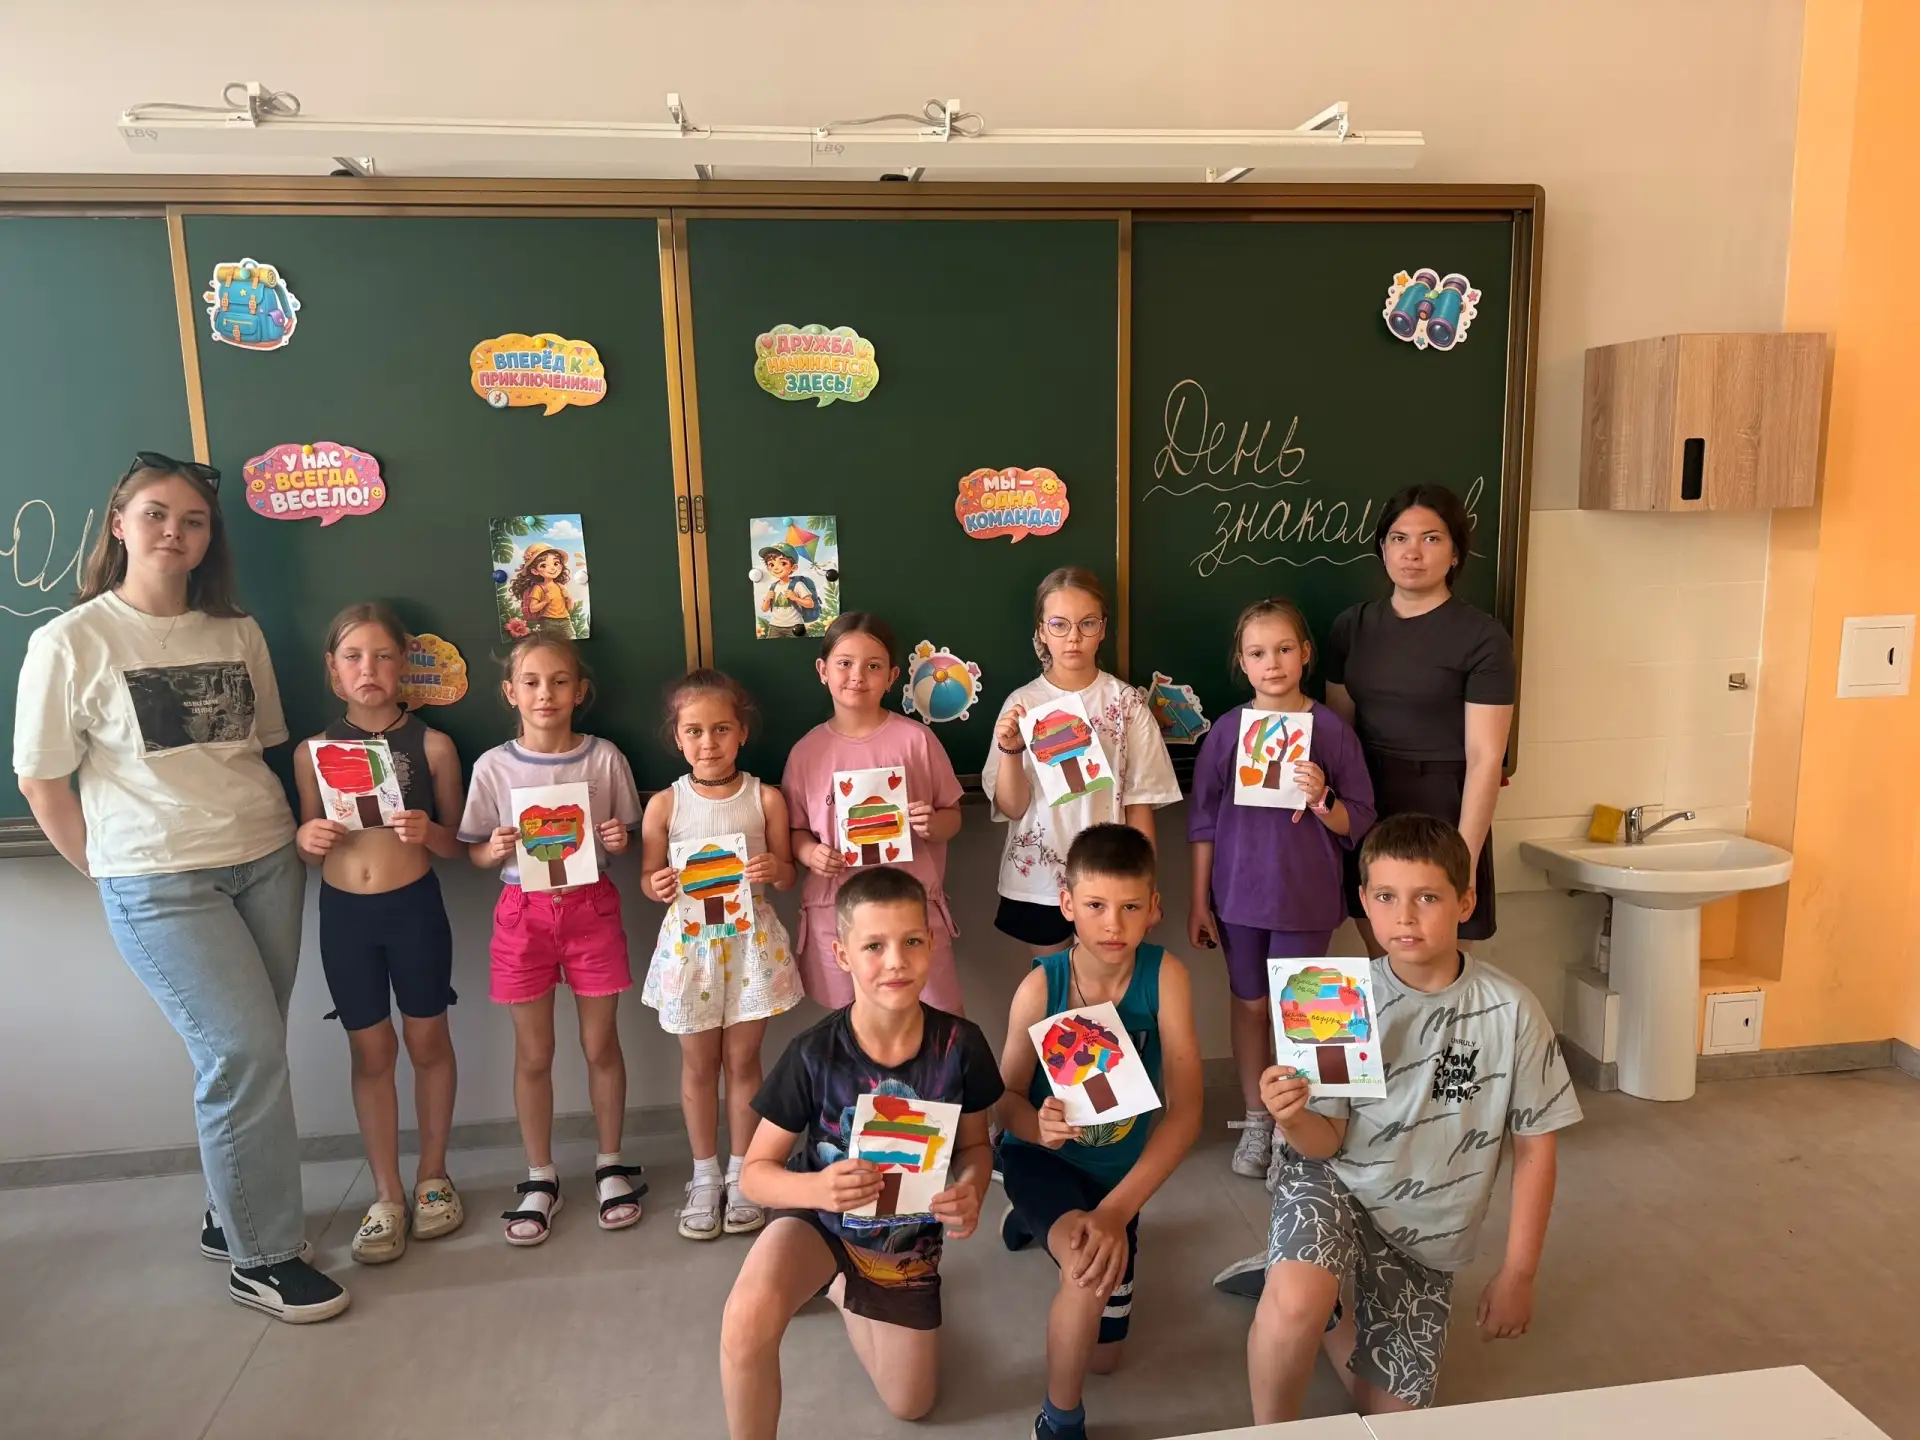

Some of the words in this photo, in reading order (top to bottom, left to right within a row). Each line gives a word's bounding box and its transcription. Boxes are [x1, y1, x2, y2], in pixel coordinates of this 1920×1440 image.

[776, 334, 855, 355] ДРУЖБА
[493, 349, 565, 373] ВПЕРЁД
[570, 356, 582, 373] К
[767, 356, 869, 376] НАЧИНАЕТСЯ
[479, 372, 602, 393] ПРИКЛЮЧЕНИЯМ!
[785, 374, 853, 393] ЗДЕСЬ!
[1154, 379, 1305, 479] День
[281, 453, 297, 472] У
[301, 450, 342, 470] НАС
[274, 468, 359, 491] ВСЕГДА
[983, 476, 1016, 492] МЫ
[270, 486, 369, 513] ВЕСЕЛО!
[981, 491, 1037, 509] ОДНА
[965, 509, 1061, 532] КОМАНДА!
[1450, 1036, 1476, 1047] UNRULY
